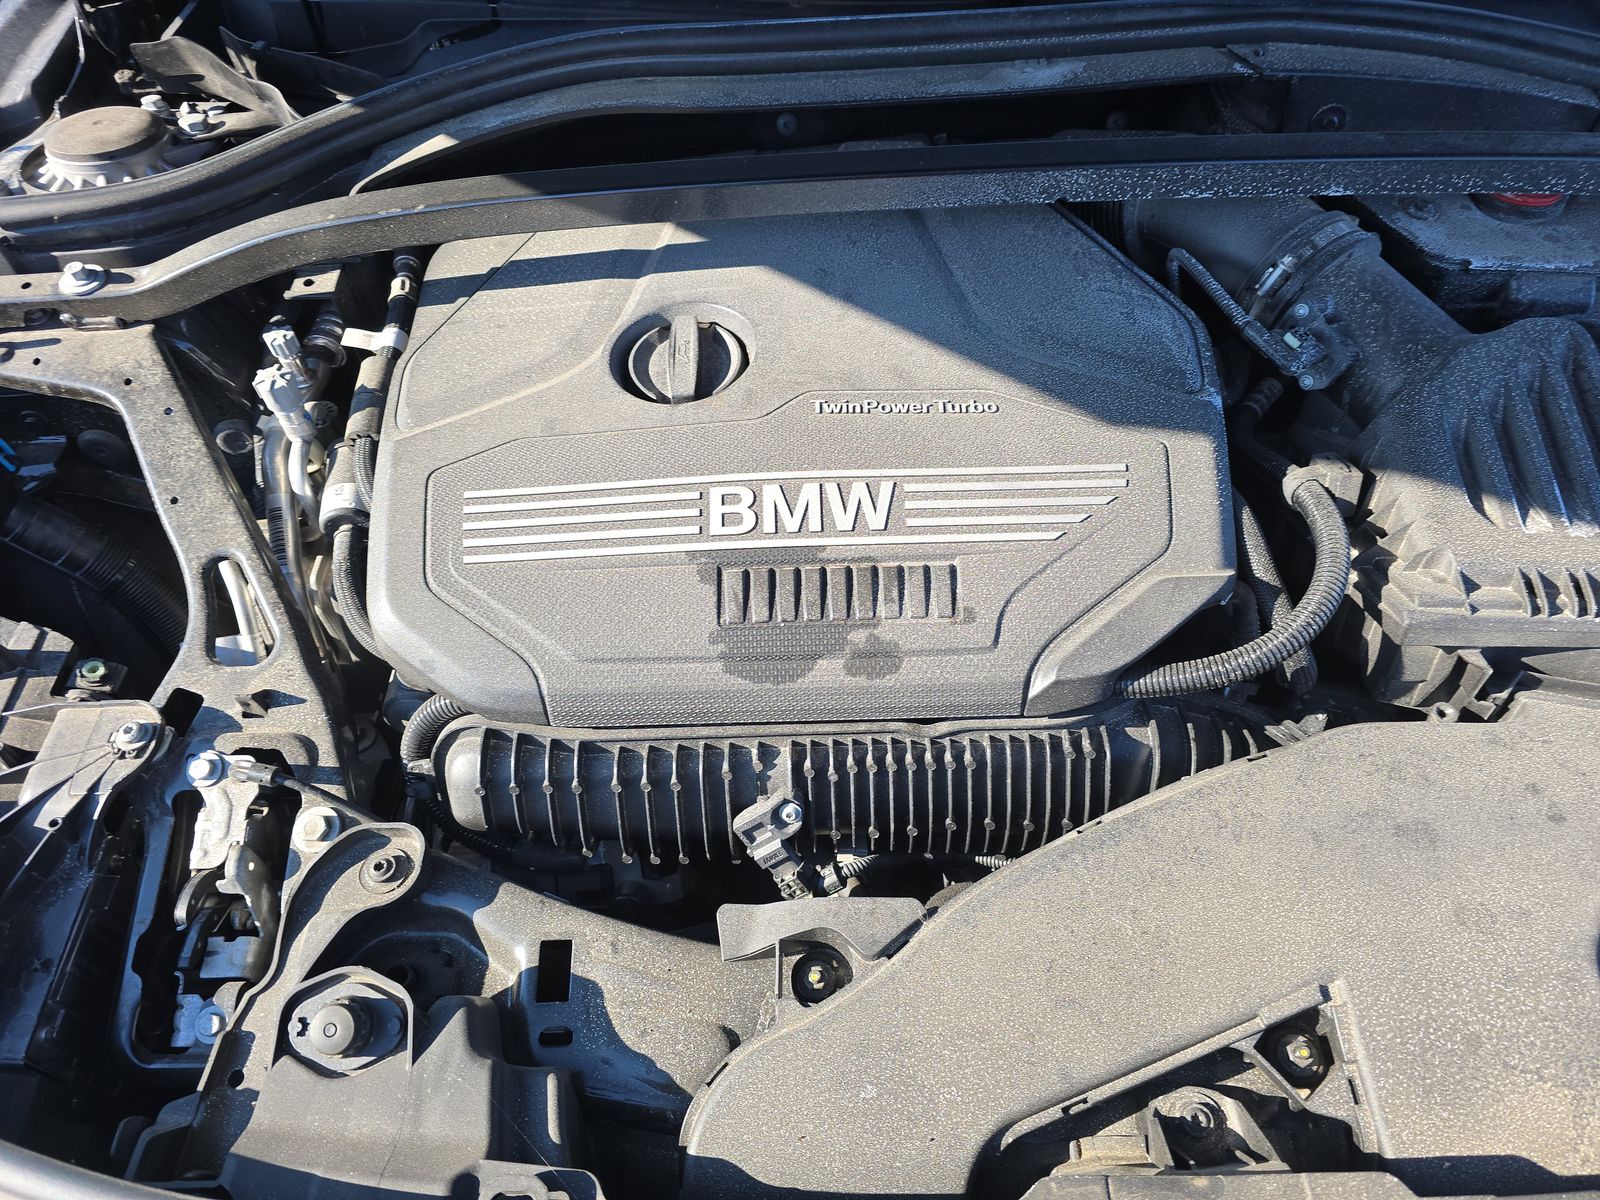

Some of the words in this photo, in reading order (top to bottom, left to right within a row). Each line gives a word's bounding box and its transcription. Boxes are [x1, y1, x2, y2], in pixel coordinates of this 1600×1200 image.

[810, 399, 932, 414] TwinPower
[933, 400, 999, 414] Turbo
[709, 481, 897, 537] BMW
